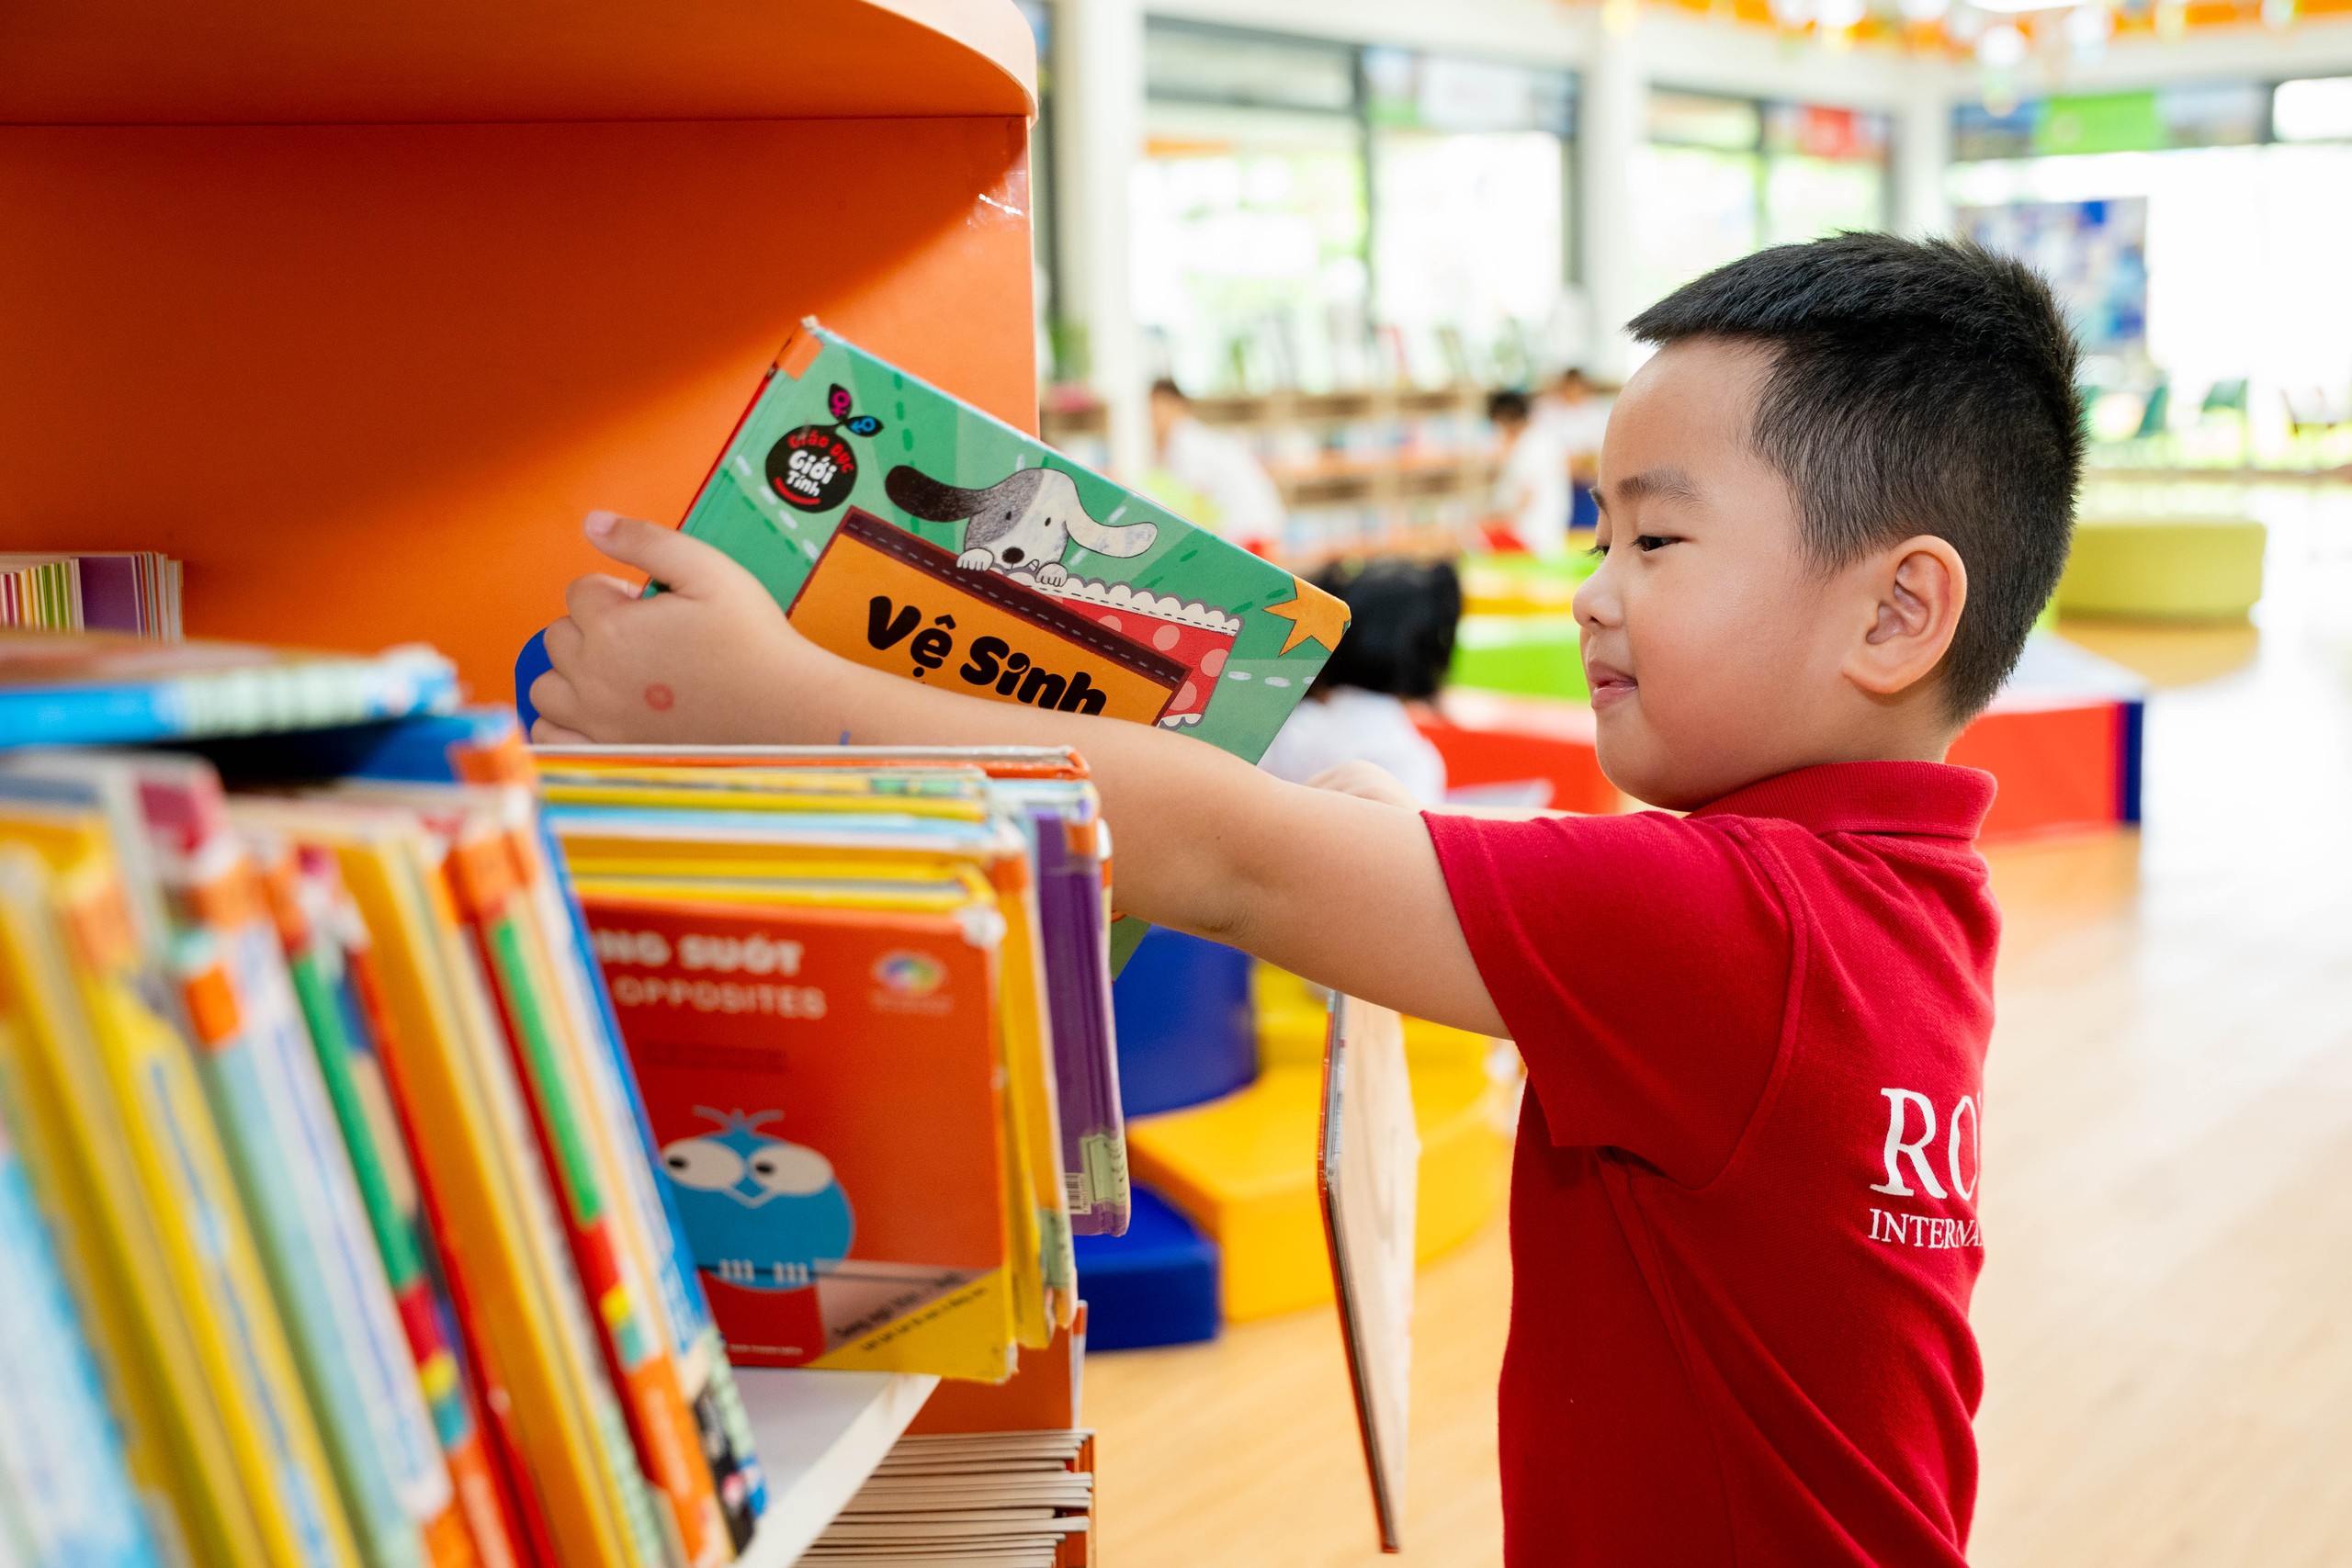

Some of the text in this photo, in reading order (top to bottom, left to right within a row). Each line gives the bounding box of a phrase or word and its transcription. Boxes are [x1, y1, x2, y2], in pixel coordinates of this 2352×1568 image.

[786, 469, 820, 497] Tính
[788, 449, 837, 485] Giới
[867, 595, 1107, 716] Vệ Sinh
[611, 975, 828, 1020] OPPOSITES
[1870, 1088, 1982, 1201] RO
